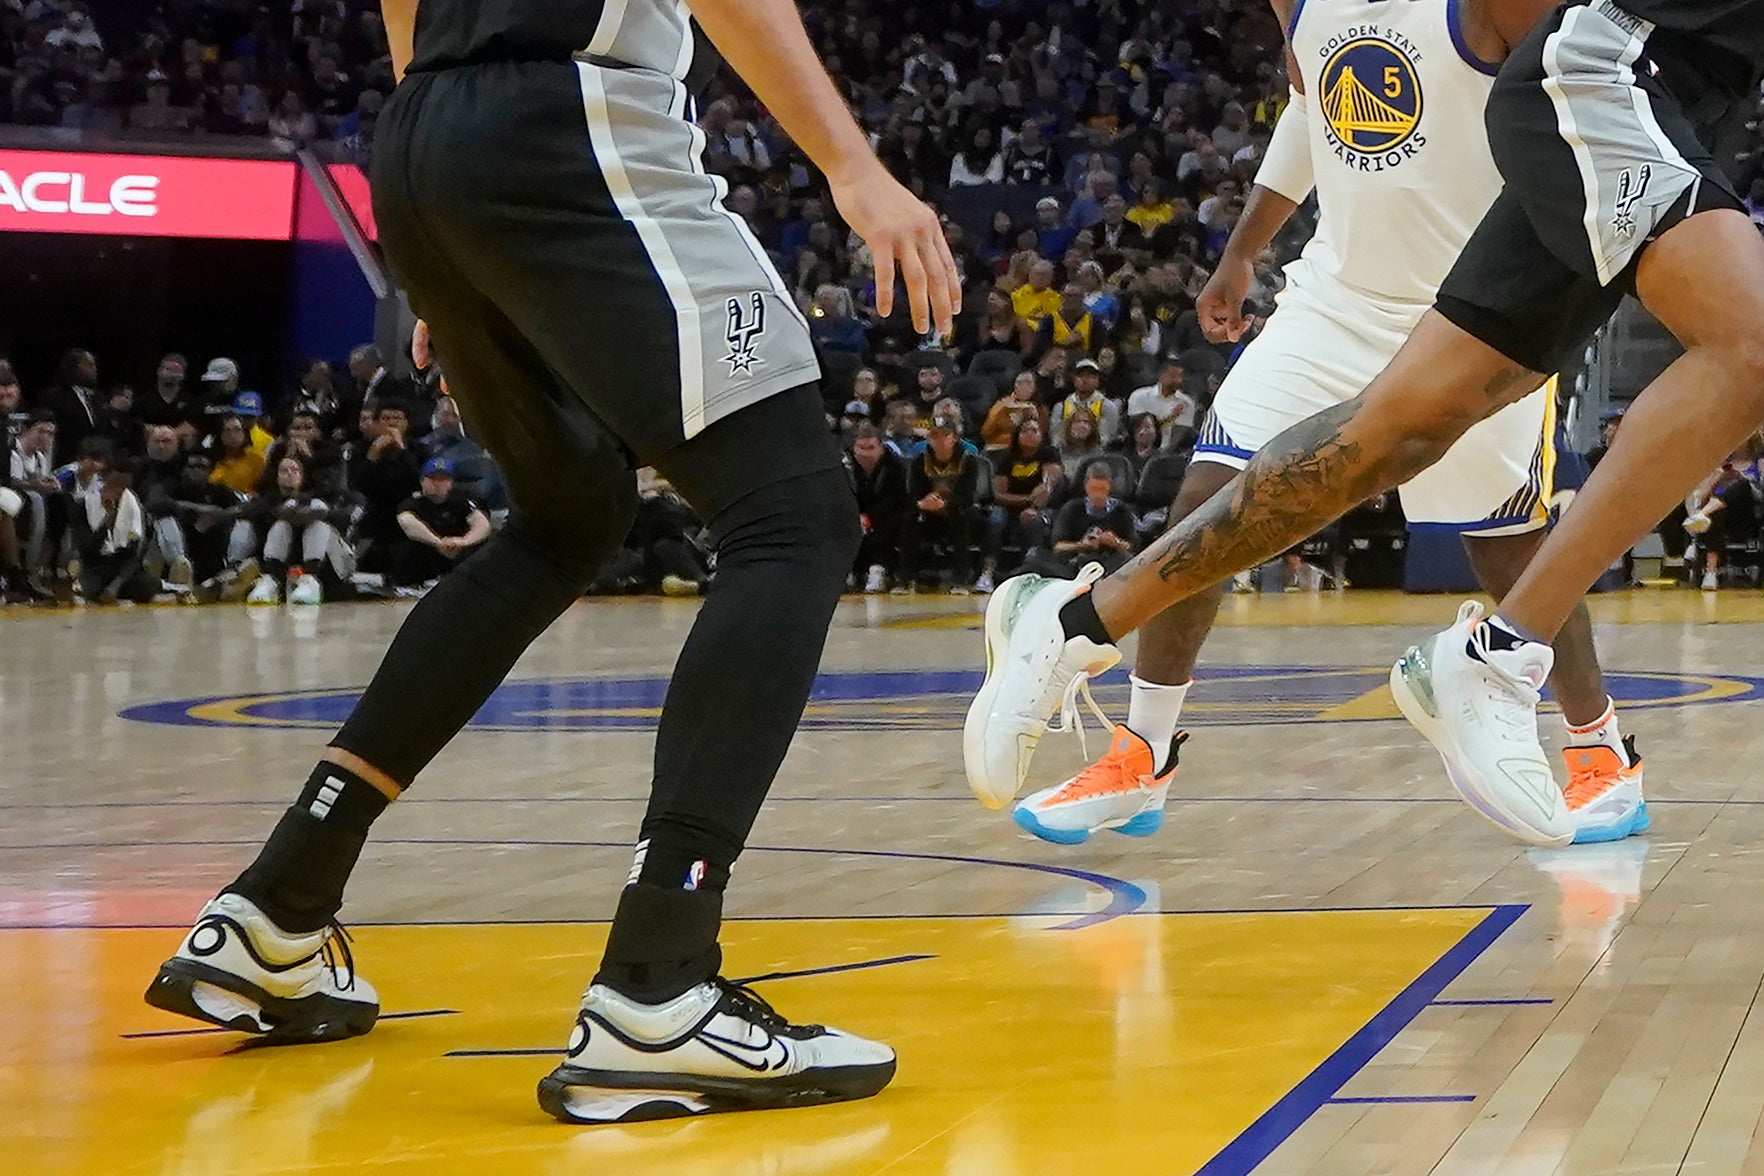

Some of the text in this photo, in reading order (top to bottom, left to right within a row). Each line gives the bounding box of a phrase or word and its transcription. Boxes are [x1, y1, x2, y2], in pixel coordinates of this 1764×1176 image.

[1319, 25, 1424, 64] GOLDEN STATE
[1383, 66, 1403, 99] 5
[1324, 126, 1427, 172] WARRIORS
